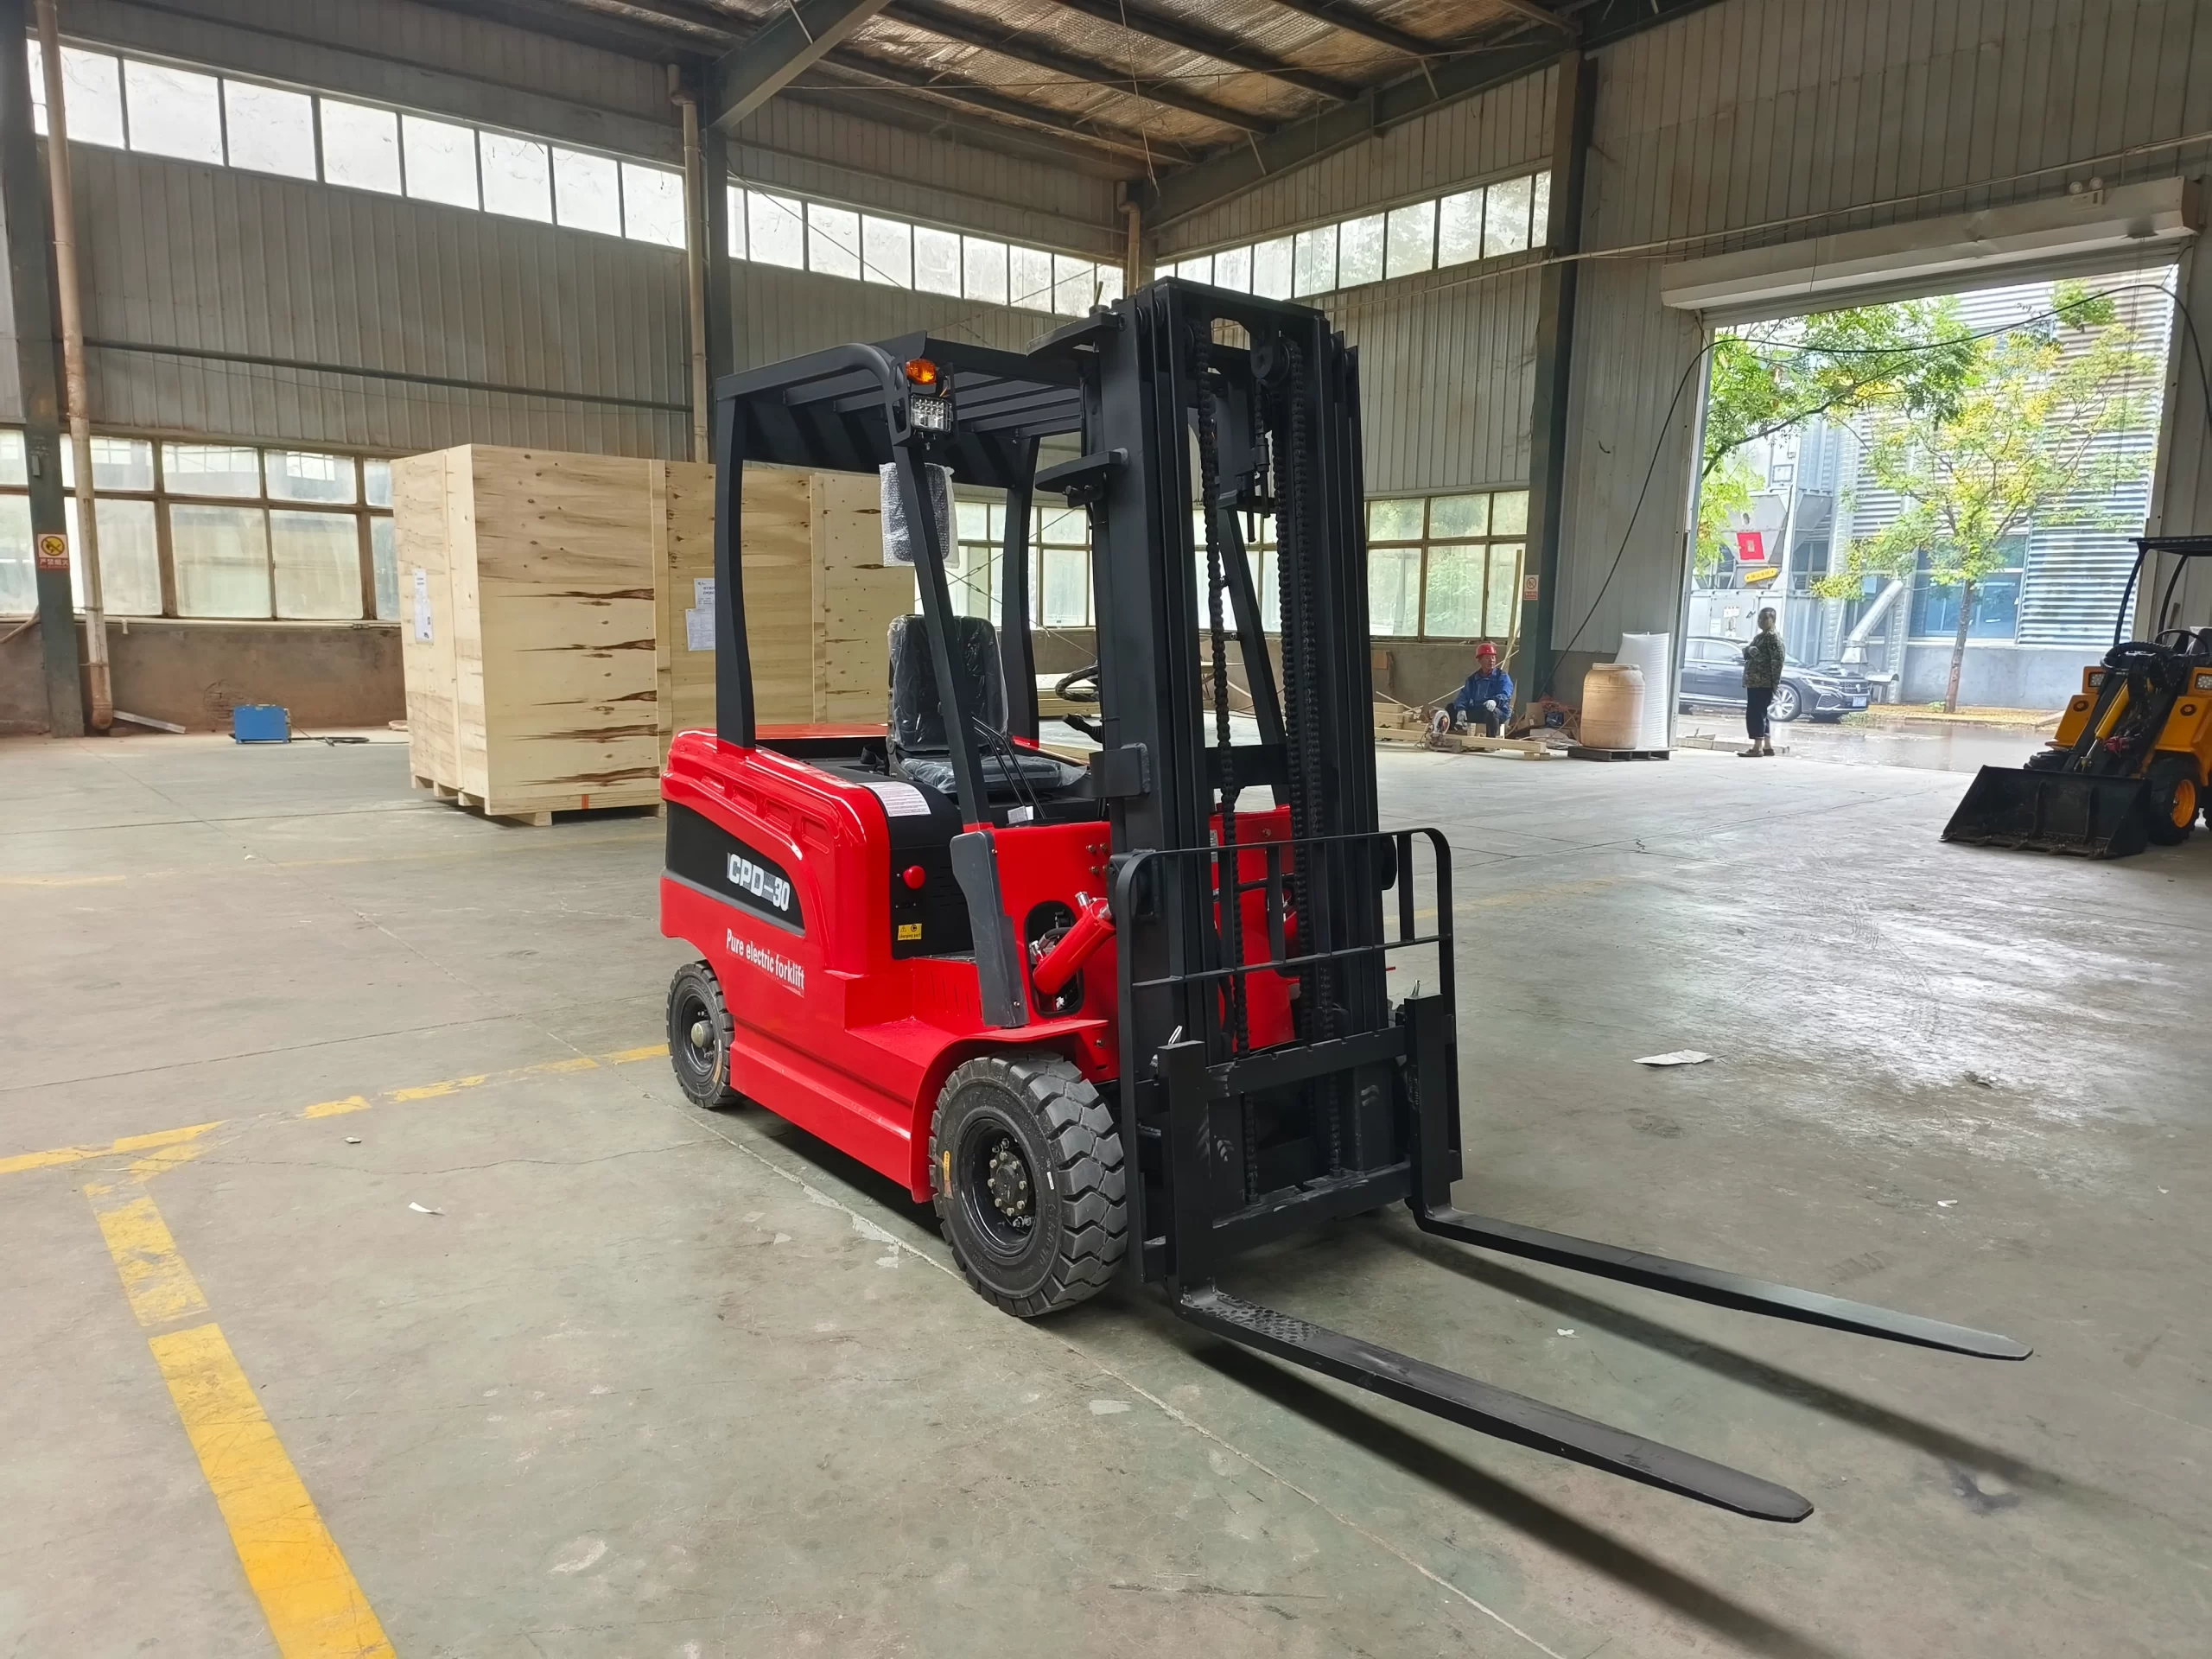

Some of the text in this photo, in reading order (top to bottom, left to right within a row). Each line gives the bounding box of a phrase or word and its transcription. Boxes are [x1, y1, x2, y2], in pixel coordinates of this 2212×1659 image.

[729, 854, 790, 911] CPD-30
[727, 927, 804, 990] Pure electric forklift
